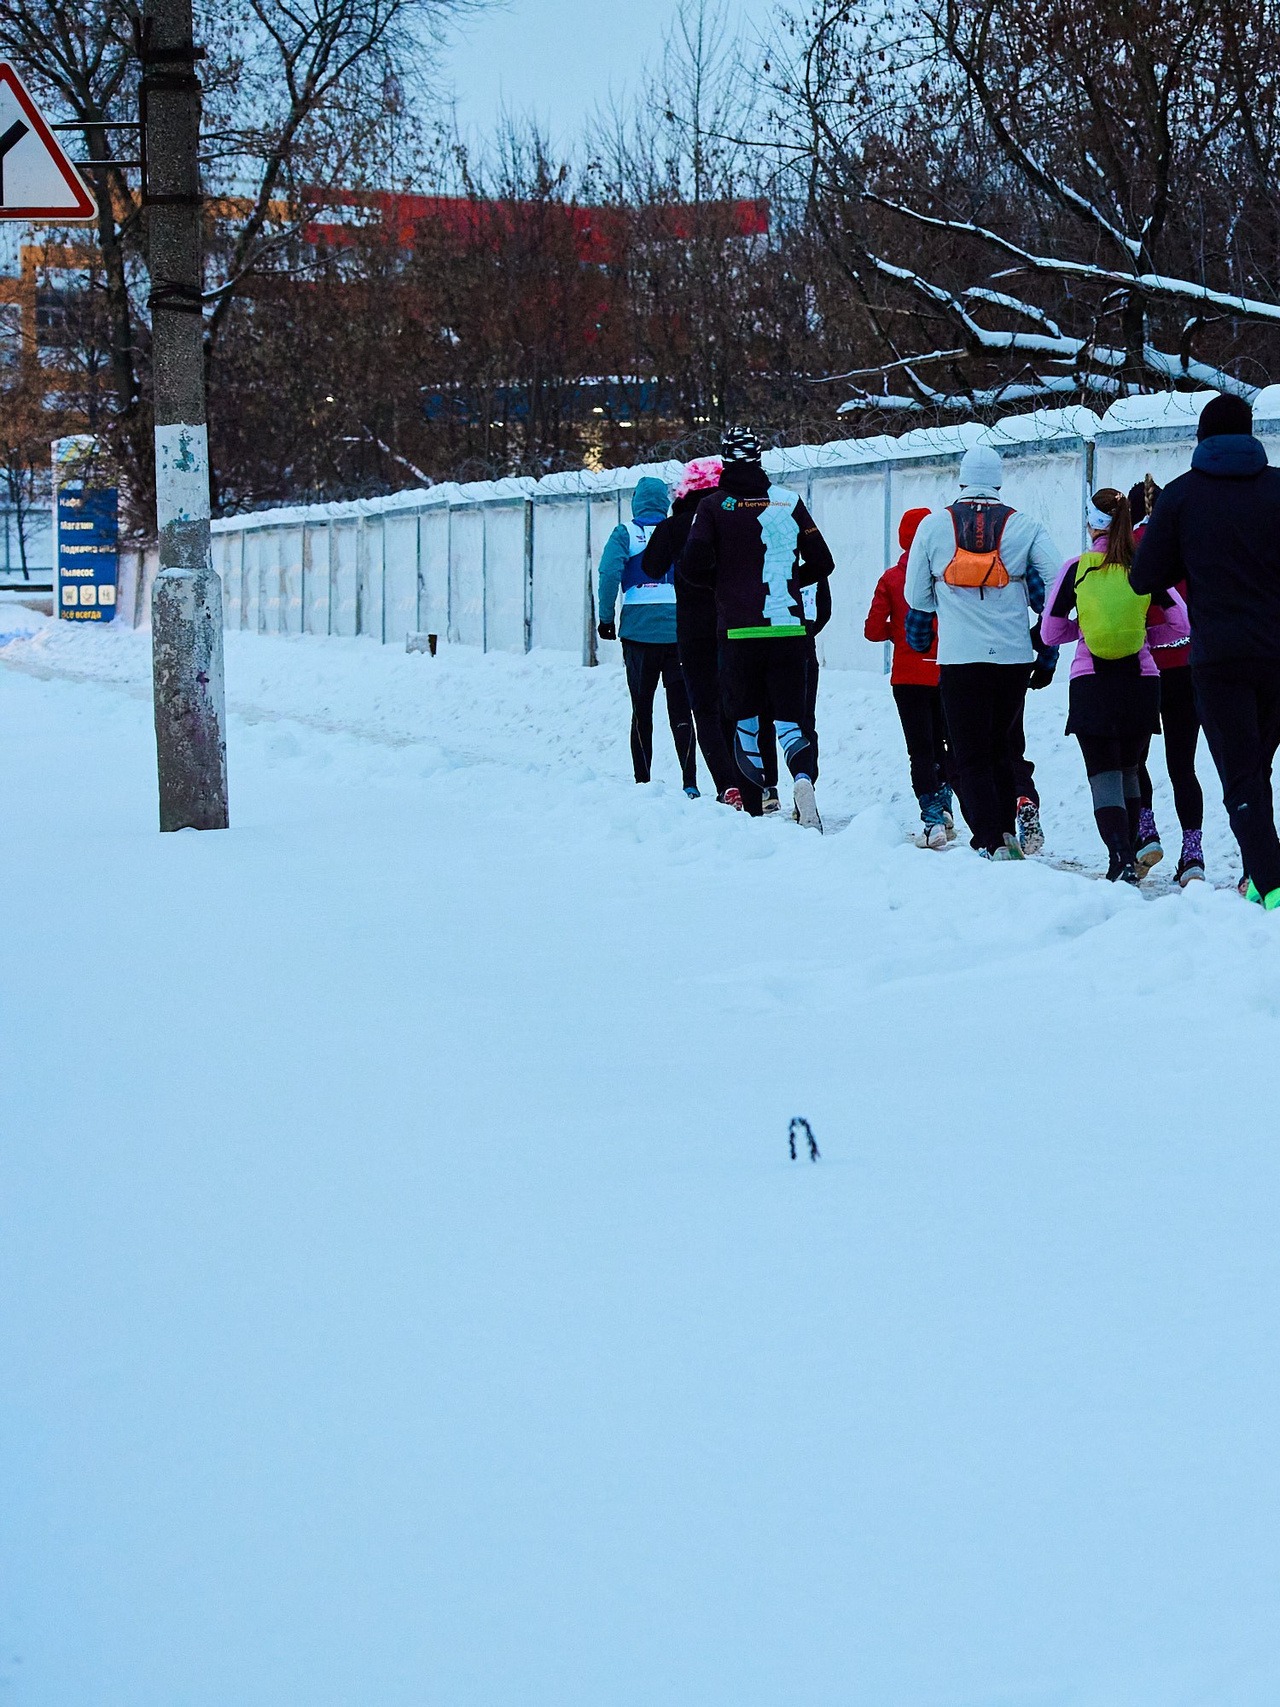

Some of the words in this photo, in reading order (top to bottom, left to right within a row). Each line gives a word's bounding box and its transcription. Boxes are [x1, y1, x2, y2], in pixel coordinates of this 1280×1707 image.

[61, 521, 94, 530] Магазин
[61, 544, 98, 554] Подкачка
[61, 568, 94, 577] Пылесос
